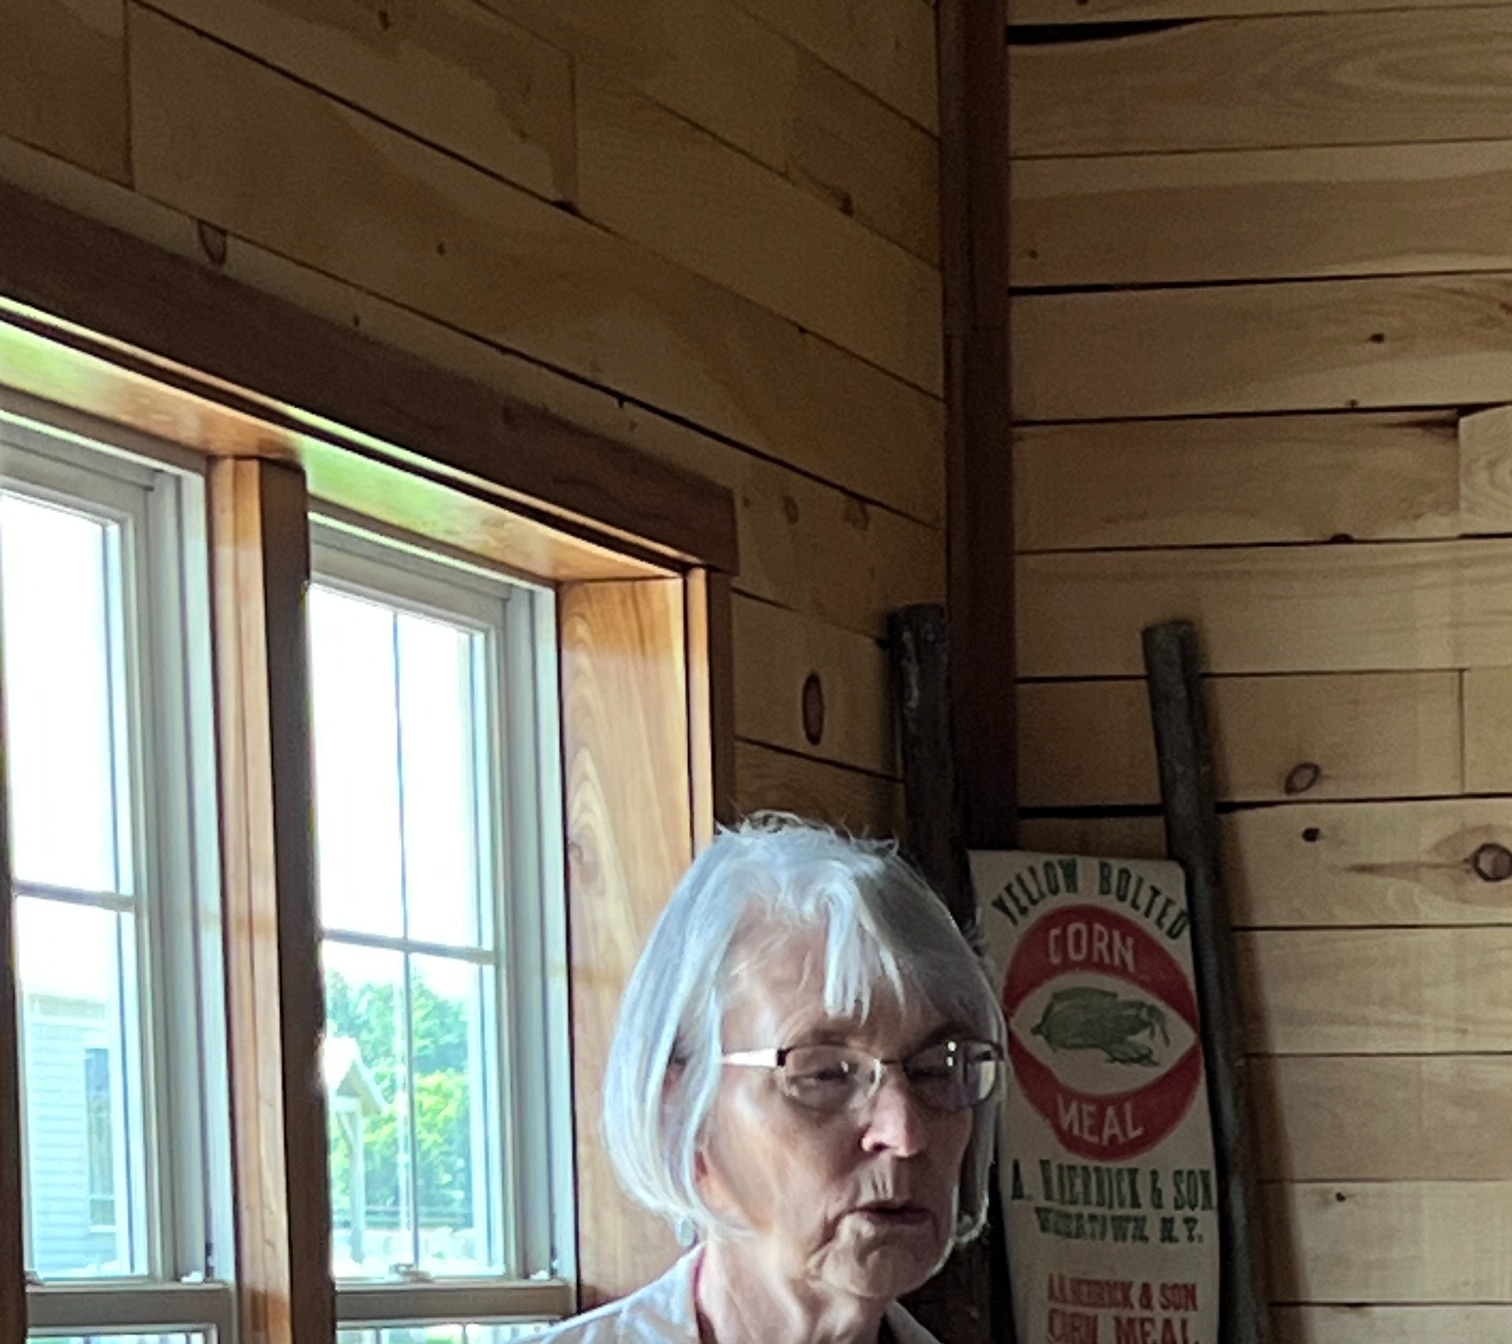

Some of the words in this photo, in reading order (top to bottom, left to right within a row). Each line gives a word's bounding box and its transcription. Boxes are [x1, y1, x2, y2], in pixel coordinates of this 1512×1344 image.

[990, 858, 1078, 926] YELLOW
[1098, 860, 1192, 940] BOLTED
[1048, 921, 1136, 973] CORN
[1150, 1169, 1164, 1210] &
[1173, 1169, 1214, 1211] SON
[1139, 1282, 1153, 1311] &
[1160, 1282, 1198, 1312] SON
